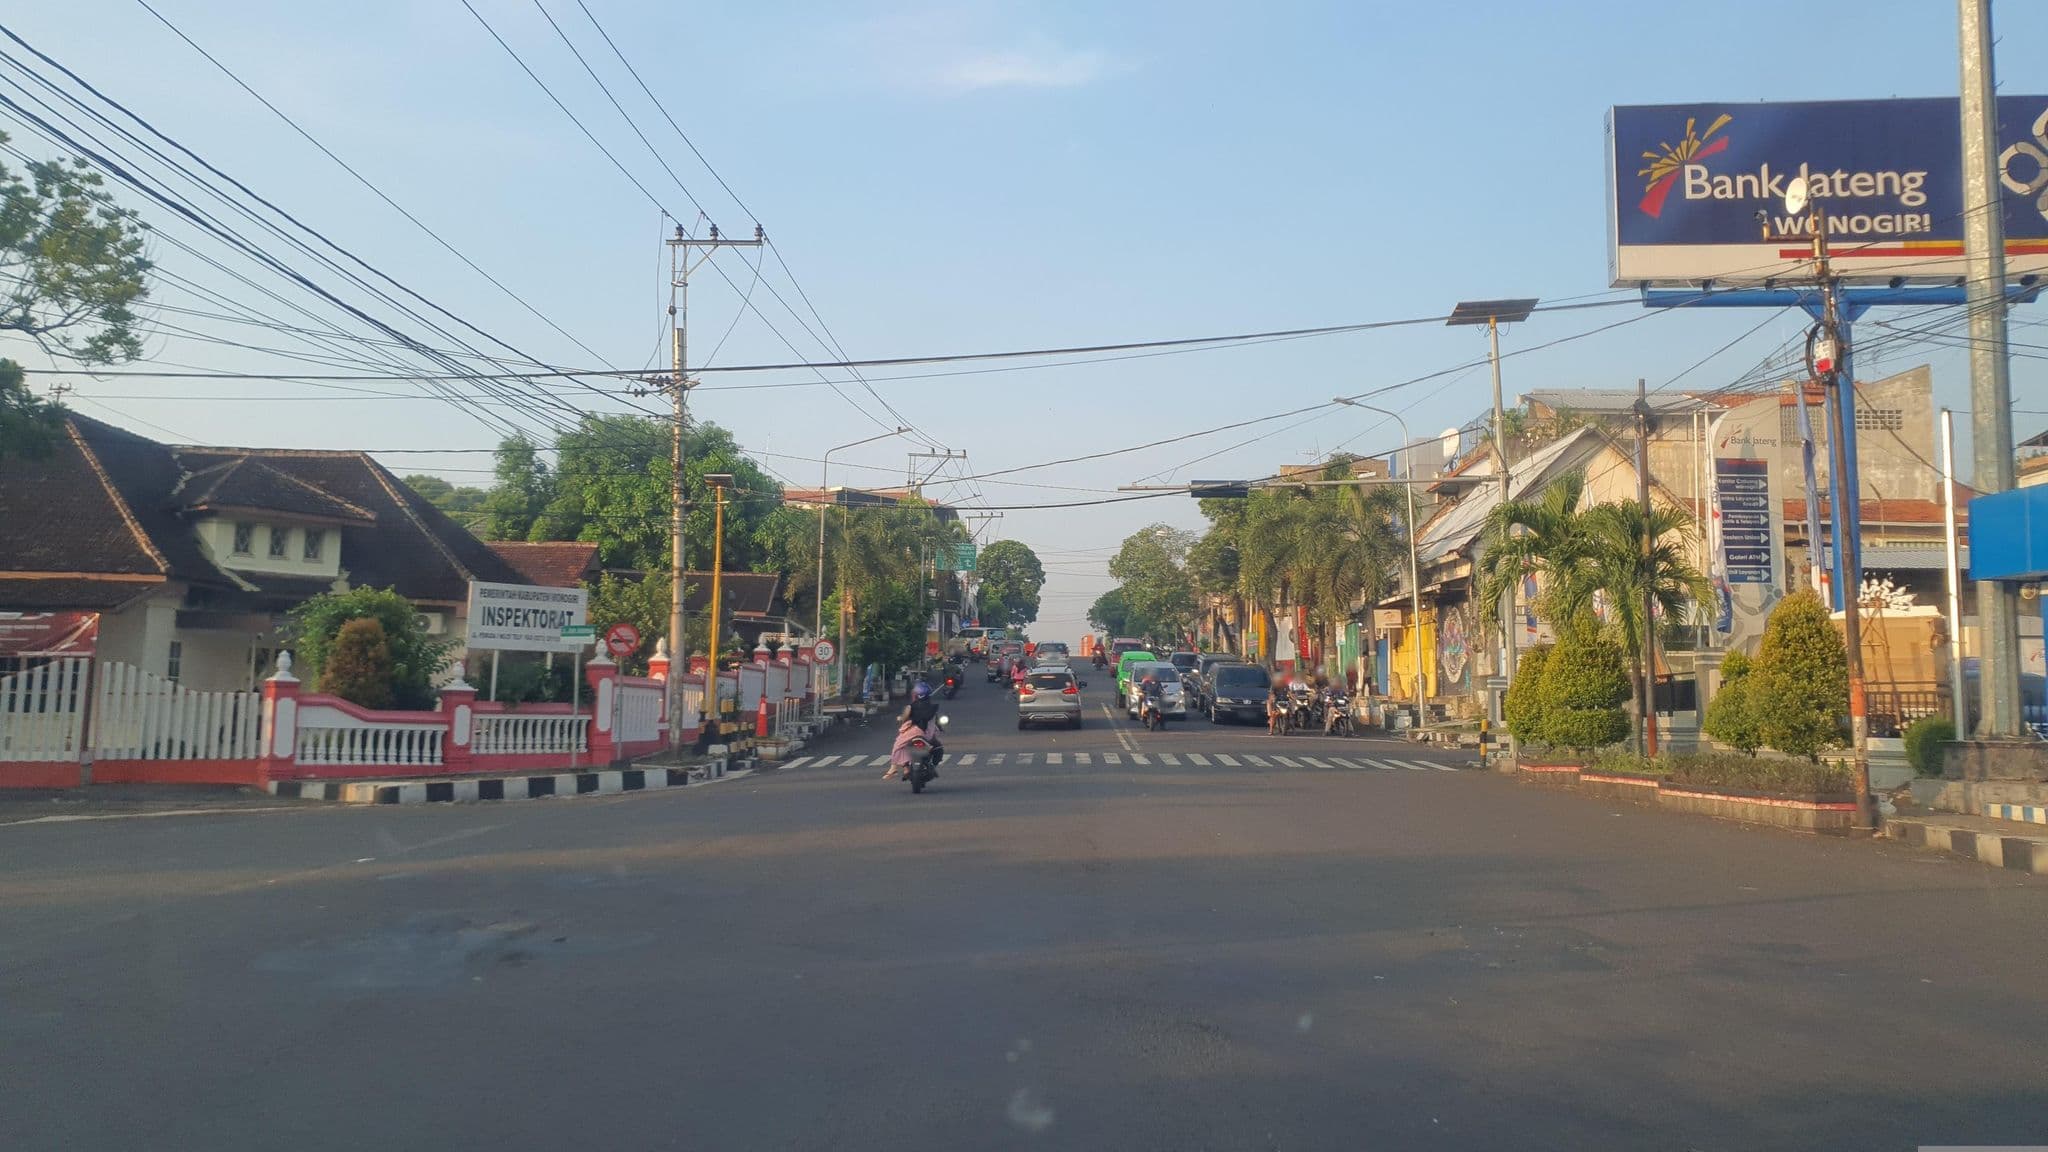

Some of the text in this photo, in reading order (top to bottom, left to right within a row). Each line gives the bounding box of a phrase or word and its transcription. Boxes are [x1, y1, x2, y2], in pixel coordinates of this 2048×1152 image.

[1684, 162, 1786, 200] Bank
[1730, 436, 1750, 444] Bank
[481, 606, 574, 629] INSPEKTORAT
[818, 647, 829, 656] 30
